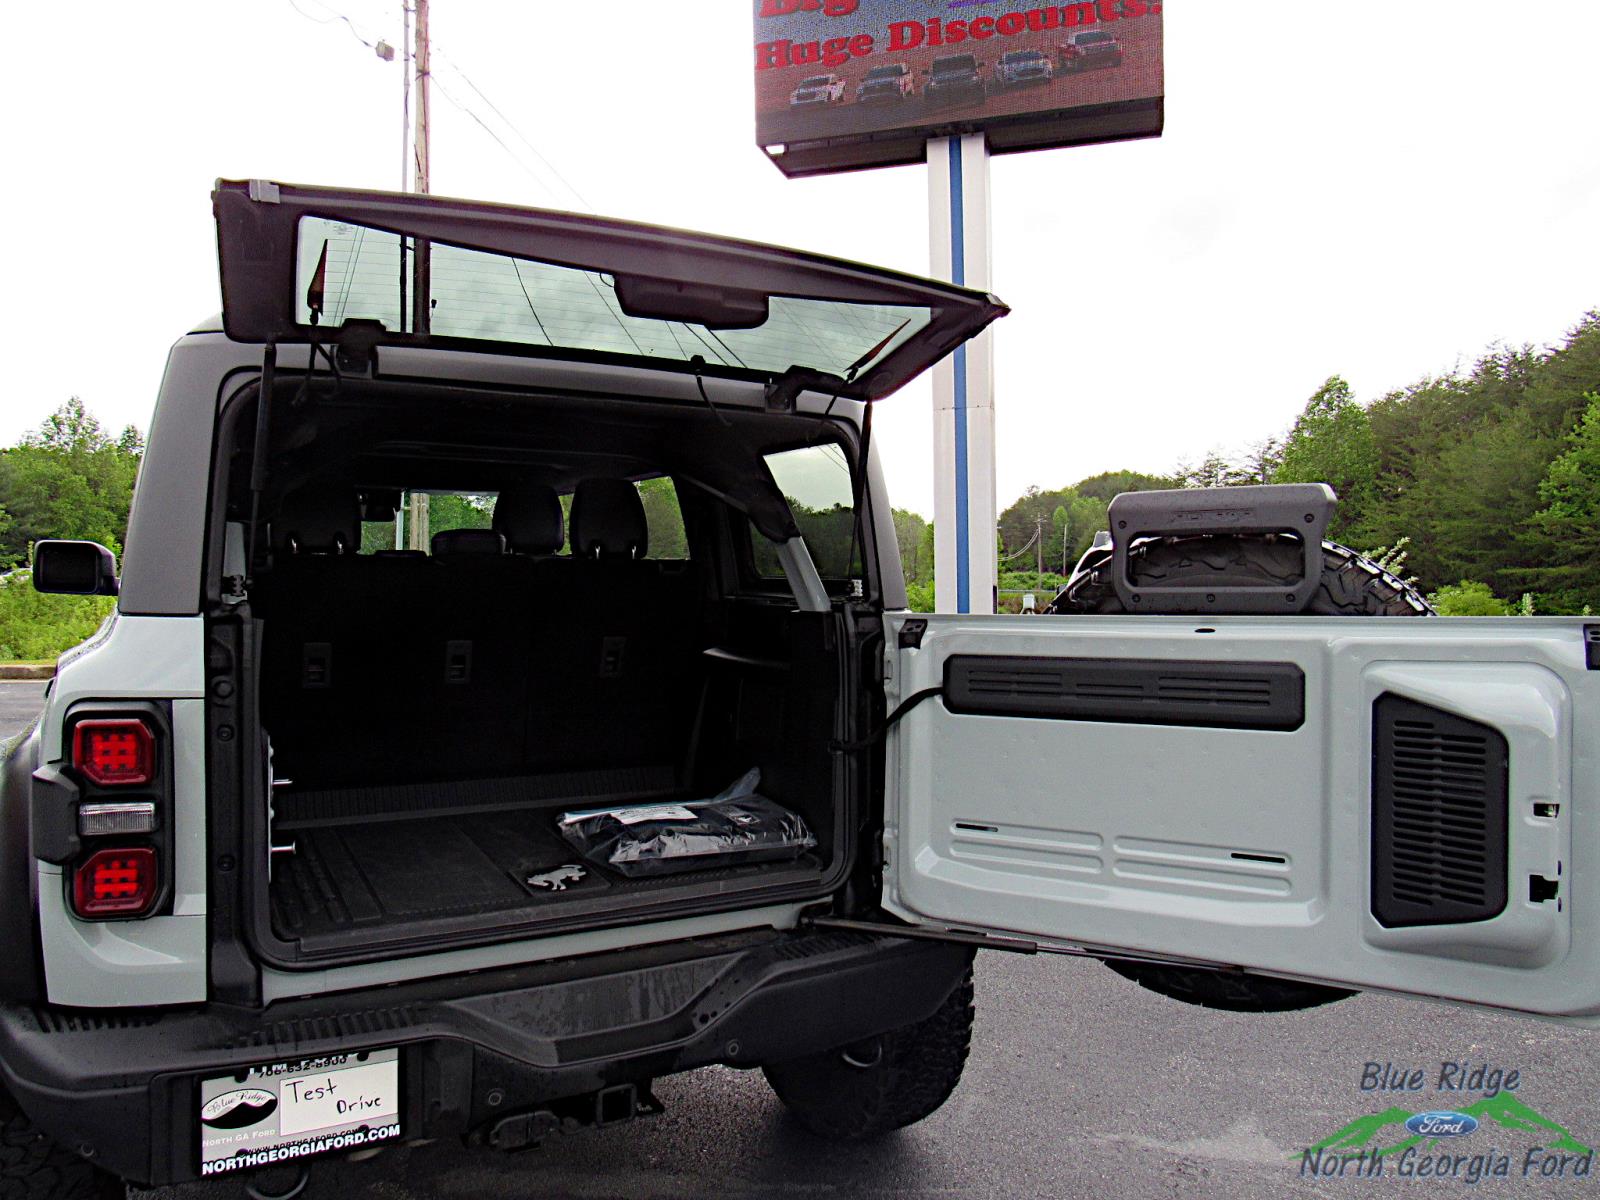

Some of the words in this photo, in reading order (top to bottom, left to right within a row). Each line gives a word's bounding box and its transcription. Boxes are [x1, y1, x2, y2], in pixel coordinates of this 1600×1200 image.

[755, 34, 874, 70] Huge
[285, 1078, 338, 1103] Test
[337, 1095, 381, 1114] Drive
[202, 1124, 400, 1176] NORTHGEORGIAFORD.COM
